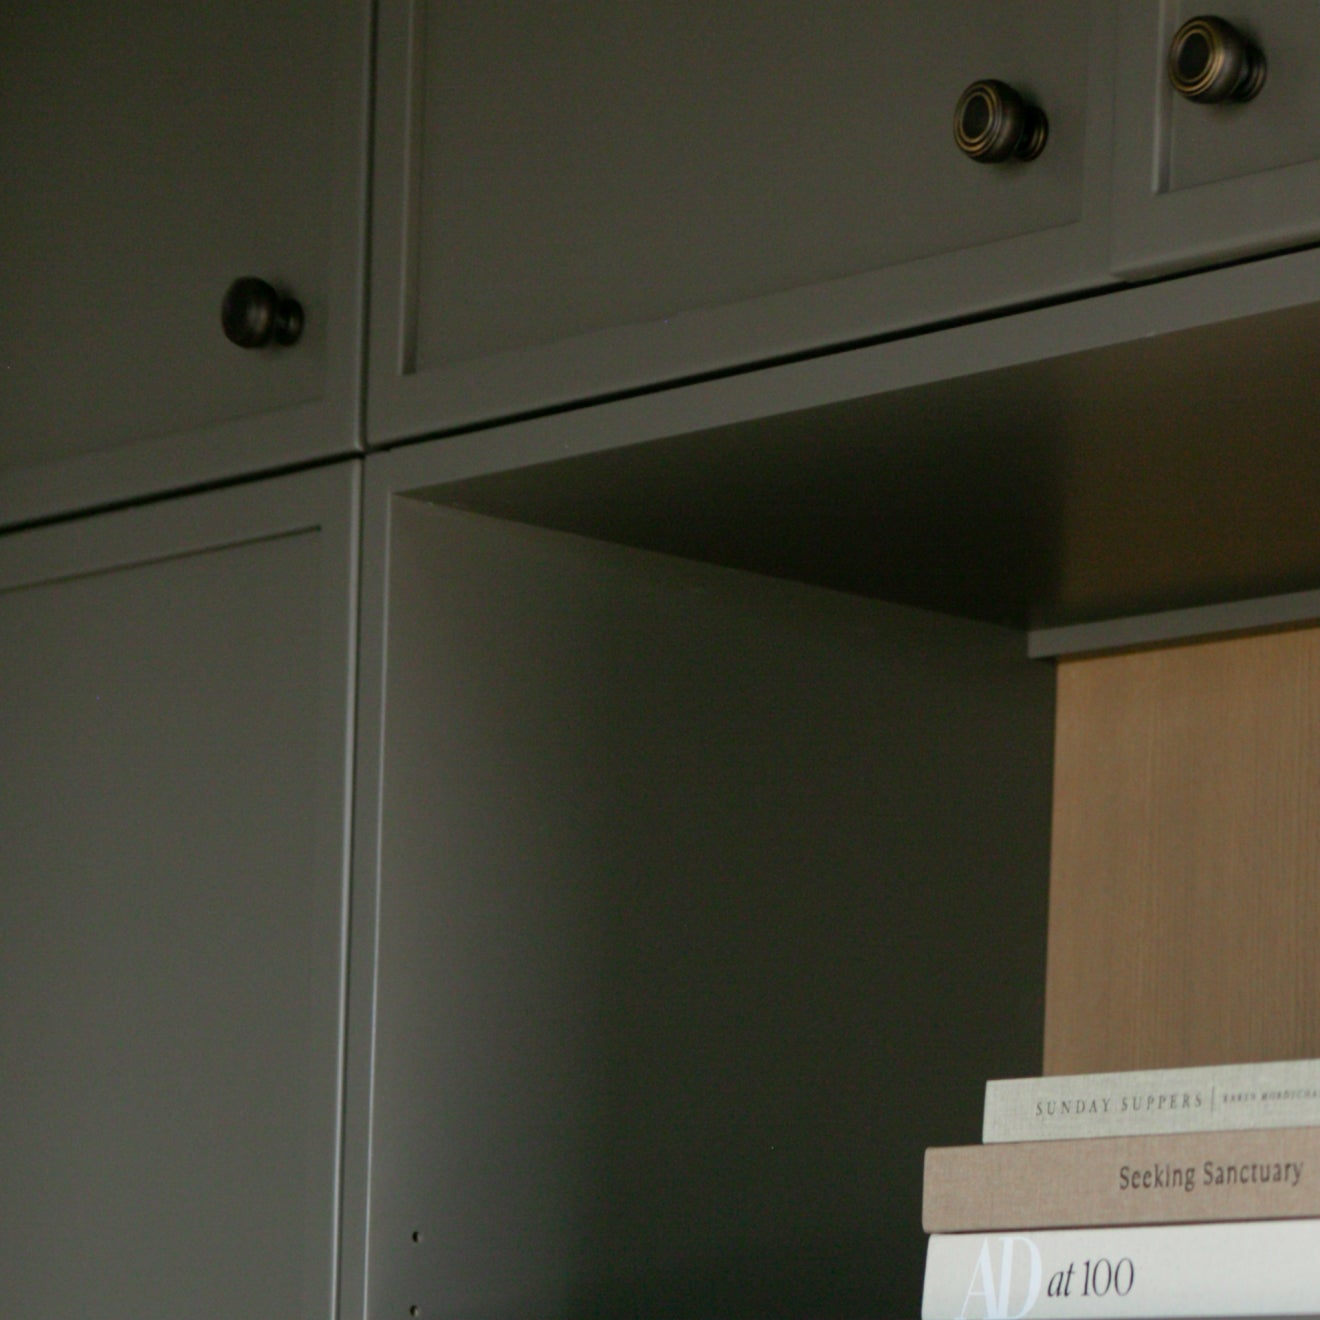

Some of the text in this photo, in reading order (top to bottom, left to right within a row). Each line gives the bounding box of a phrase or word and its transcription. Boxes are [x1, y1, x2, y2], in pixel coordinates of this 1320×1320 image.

[1035, 1098, 1112, 1117] SUNDAY
[1120, 1092, 1204, 1112] SUPPERS
[1119, 1160, 1305, 1193] Seeking Sanctuary
[1046, 1261, 1077, 1298] at
[1080, 1257, 1136, 1297] 100
